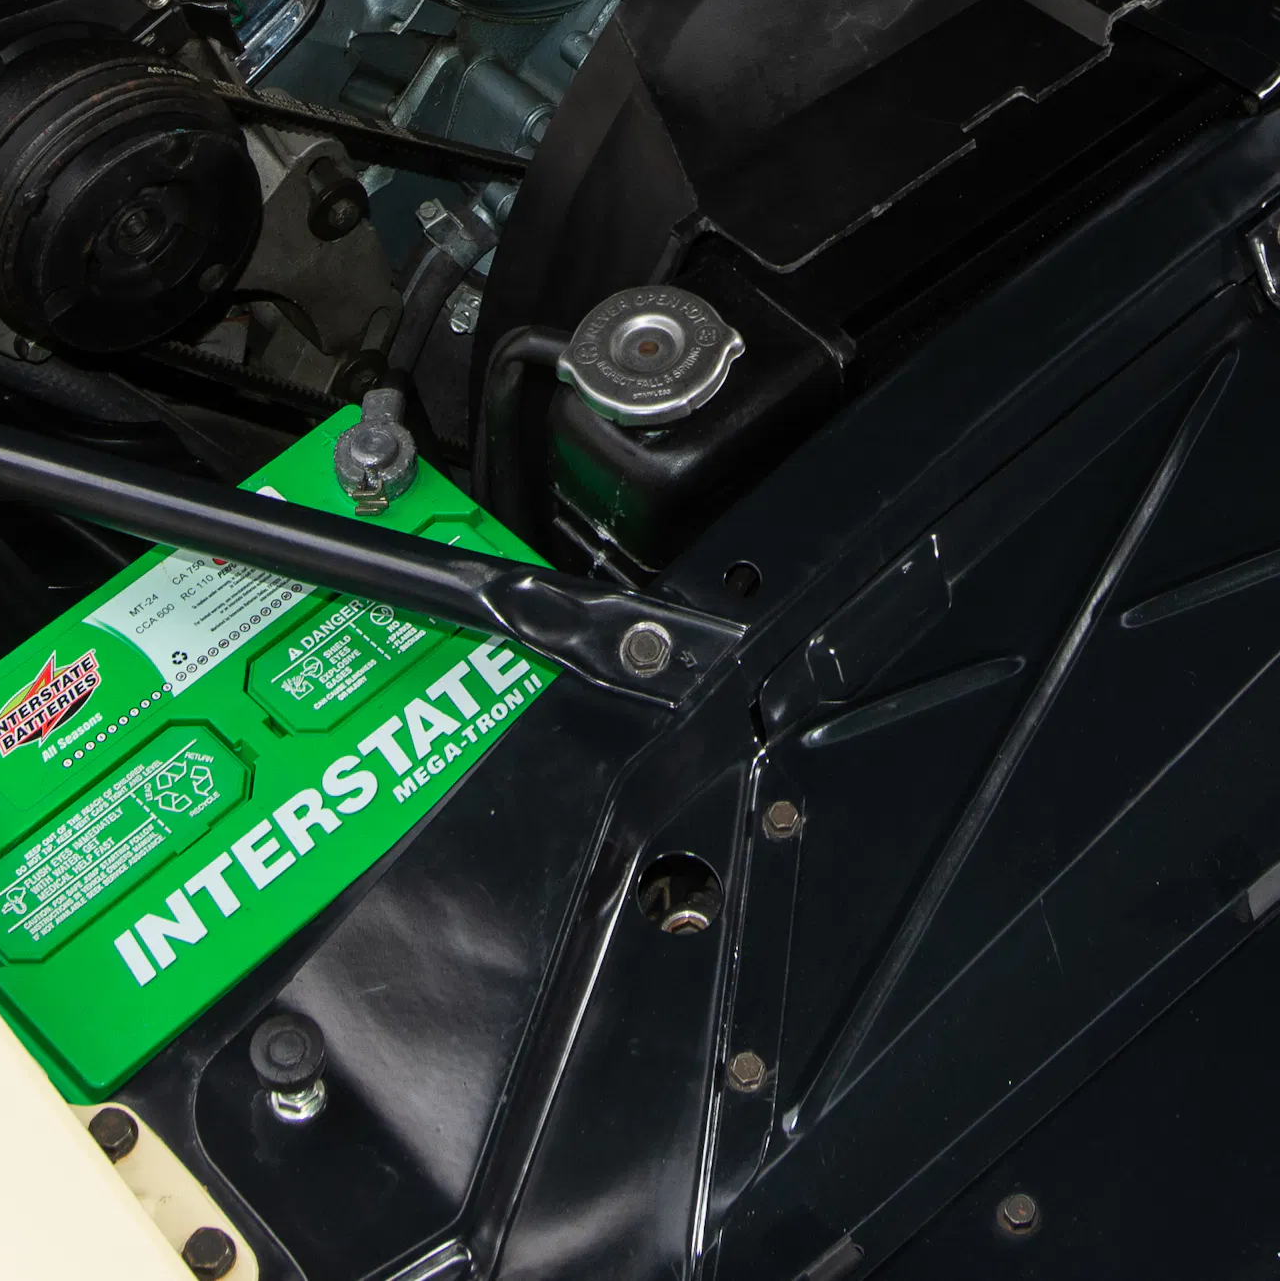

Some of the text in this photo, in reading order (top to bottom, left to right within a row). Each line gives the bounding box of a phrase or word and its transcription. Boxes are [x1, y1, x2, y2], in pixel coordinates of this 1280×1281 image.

[586, 294, 708, 338] NEVER OPEN HOT
[636, 378, 663, 388] FALL
[673, 347, 701, 379] SPRING
[172, 559, 205, 585] CA 750
[180, 574, 214, 601] RC 110
[129, 594, 159, 617] MT-24
[135, 603, 175, 634] CCA 600
[300, 598, 363, 650] DANGER
[386, 620, 400, 633] NO
[390, 622, 412, 641] SPARKS
[394, 627, 418, 647] FLAMES
[399, 630, 426, 653] SMOKING
[323, 635, 351, 658] SHIELD
[329, 646, 351, 664] EYES
[313, 659, 377, 709] CAN CAUSE BLINDNESS
[319, 649, 361, 683] EXPLOSIVE
[325, 666, 353, 689] GASES
[337, 676, 367, 700] OR INJURY
[2, 673, 97, 750] BATTERIES
[42, 712, 103, 762] All Seasons
[392, 673, 543, 803] MEGA-TRON II
[185, 751, 214, 763] RETURN
[114, 634, 531, 986] INTERSTATE
[145, 783, 154, 802] LEAD
[189, 792, 220, 816] RECYCLE
[16, 866, 28, 875] DO
[27, 855, 42, 866] NOT
[56, 830, 74, 844] KEEP
[73, 816, 91, 830] VENT
[91, 802, 109, 816] CAPS
[109, 786, 128, 801] TIGHT
[128, 775, 143, 787] AND
[142, 760, 162, 775] LEVEL
[24, 765, 145, 859] KEEP OUT OF THE REACH OF CHILDREN
[24, 808, 124, 887] FLUSH EYES IMMEDIATELY
[52, 895, 67, 906] FOR
[66, 882, 83, 895] SAFE
[82, 869, 100, 882] JUMP
[100, 845, 130, 869] STARTING
[129, 825, 155, 844] FOLLOW
[30, 876, 53, 894] WITH
[82, 839, 101, 853] GET
[37, 838, 116, 900] MEDICAL HELP FAST
[29, 899, 74, 934] INSTRUCTIONS
[81, 873, 107, 893] VEHICLE
[106, 852, 133, 873] OWNERS
[40, 923, 55, 934] NOT
[54, 898, 87, 923] AVAILABLE
[86, 885, 103, 898] SEEK
[102, 865, 129, 885] SERVICE
